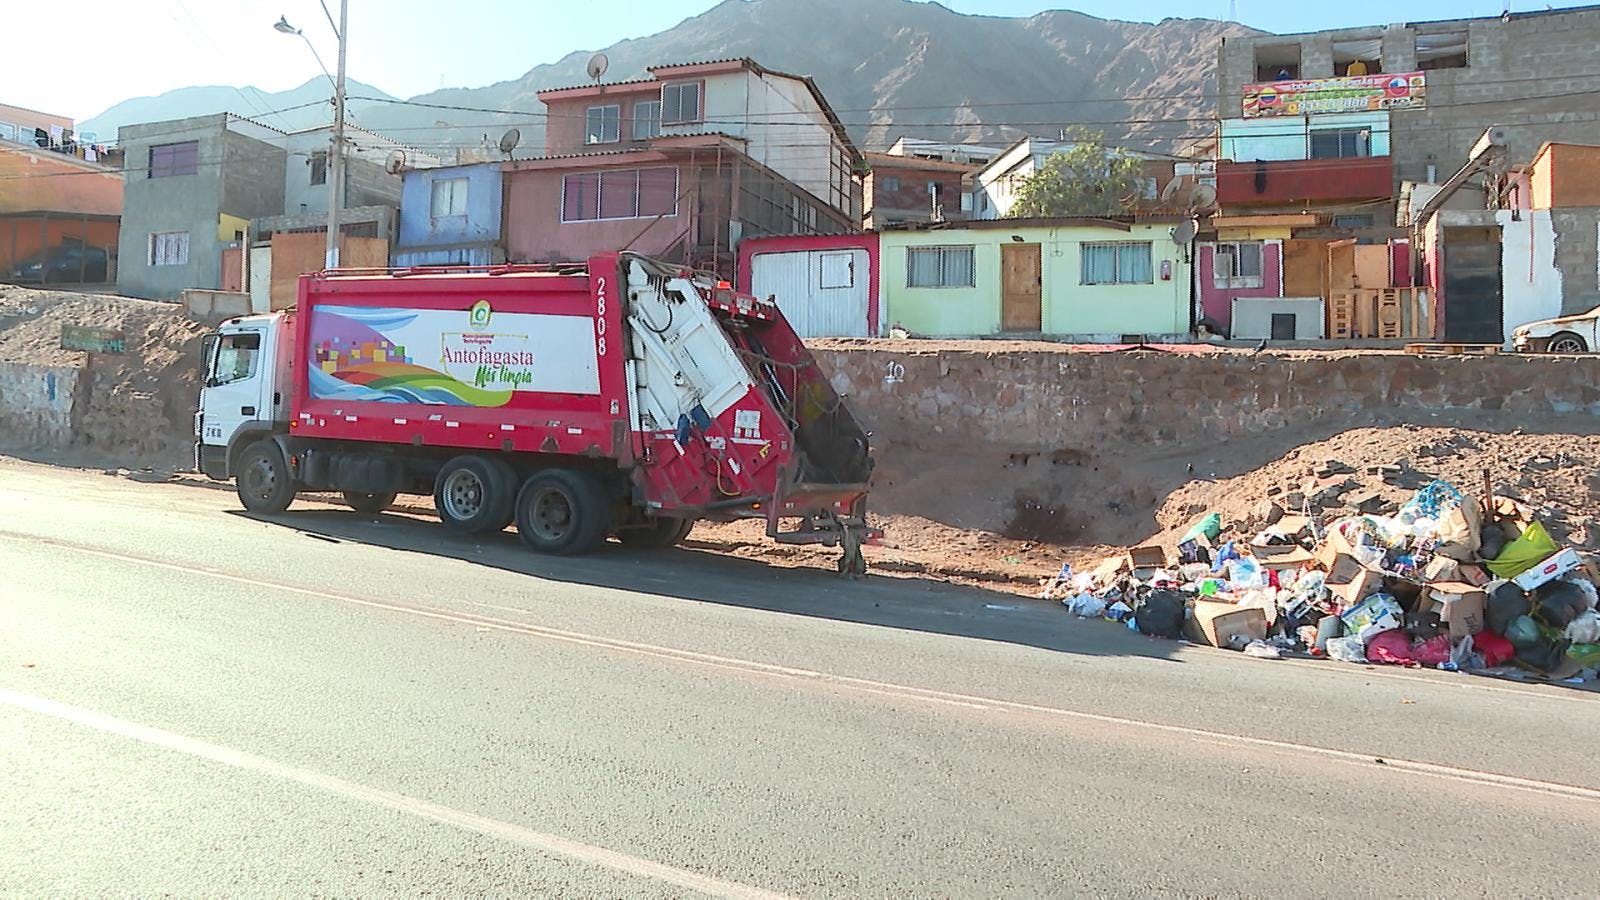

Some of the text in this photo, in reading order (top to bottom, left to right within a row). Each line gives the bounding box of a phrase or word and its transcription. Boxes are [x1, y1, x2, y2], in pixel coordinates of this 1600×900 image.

[597, 276, 606, 357] 2808
[444, 345, 534, 369] Antofagasta
[500, 365, 532, 389] limpia
